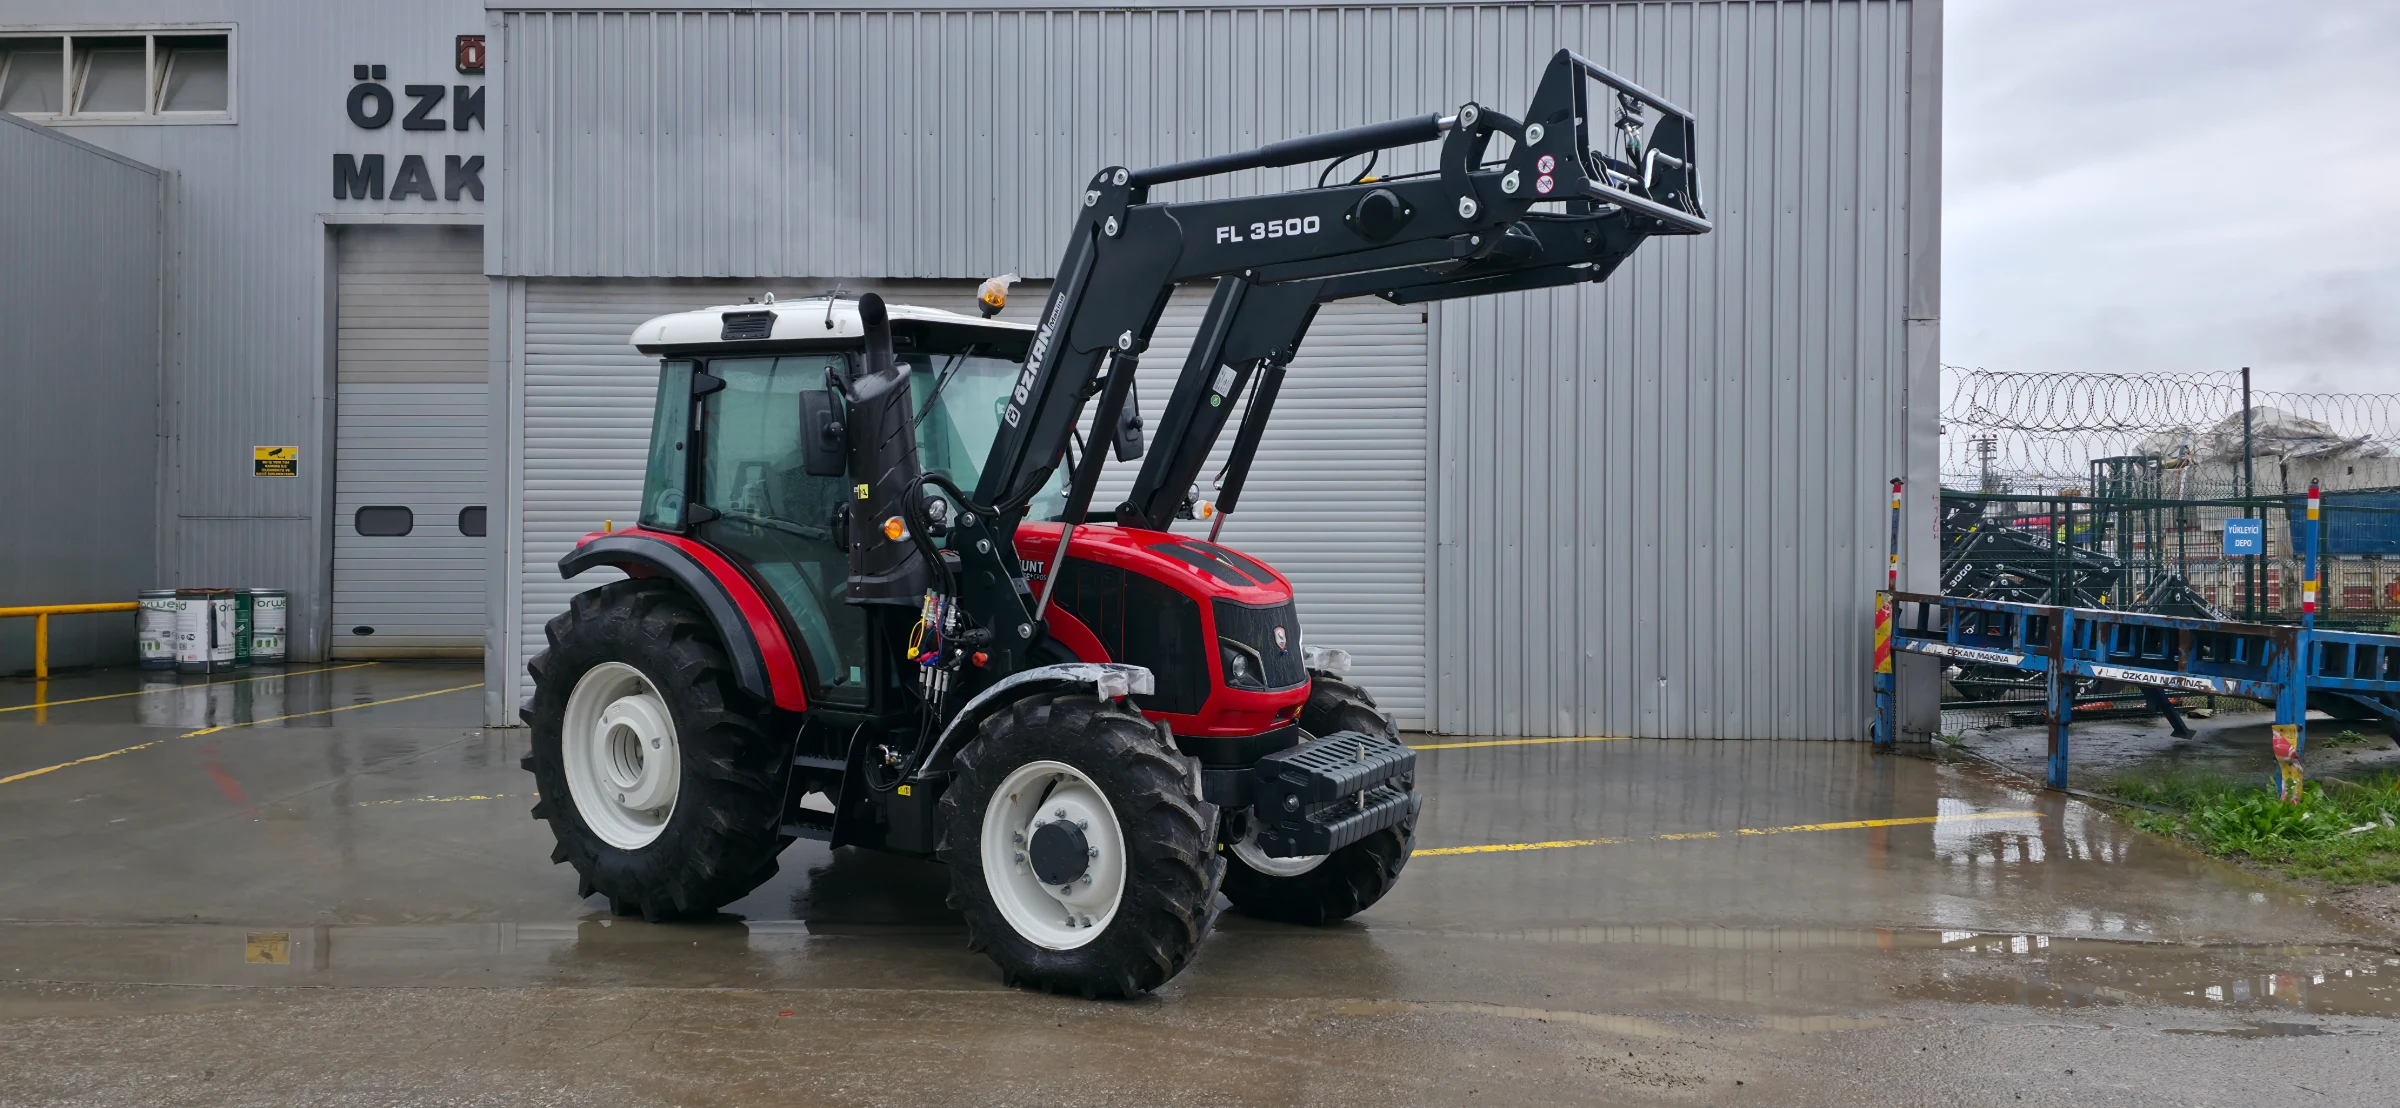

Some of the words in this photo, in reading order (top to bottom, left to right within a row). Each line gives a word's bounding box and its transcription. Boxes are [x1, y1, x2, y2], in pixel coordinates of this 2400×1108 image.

[347, 65, 485, 131] ÖZK
[333, 154, 485, 201] MAK
[1216, 226, 1243, 244] FL
[1250, 216, 1320, 240] 3500
[1014, 323, 1053, 406] ÖZKAN
[2228, 525, 2259, 534] YÜKLEYİCİ
[1020, 560, 1044, 574] UNT
[1949, 563, 1972, 588] 3000
[2122, 671, 2157, 683] ÖZKAN
